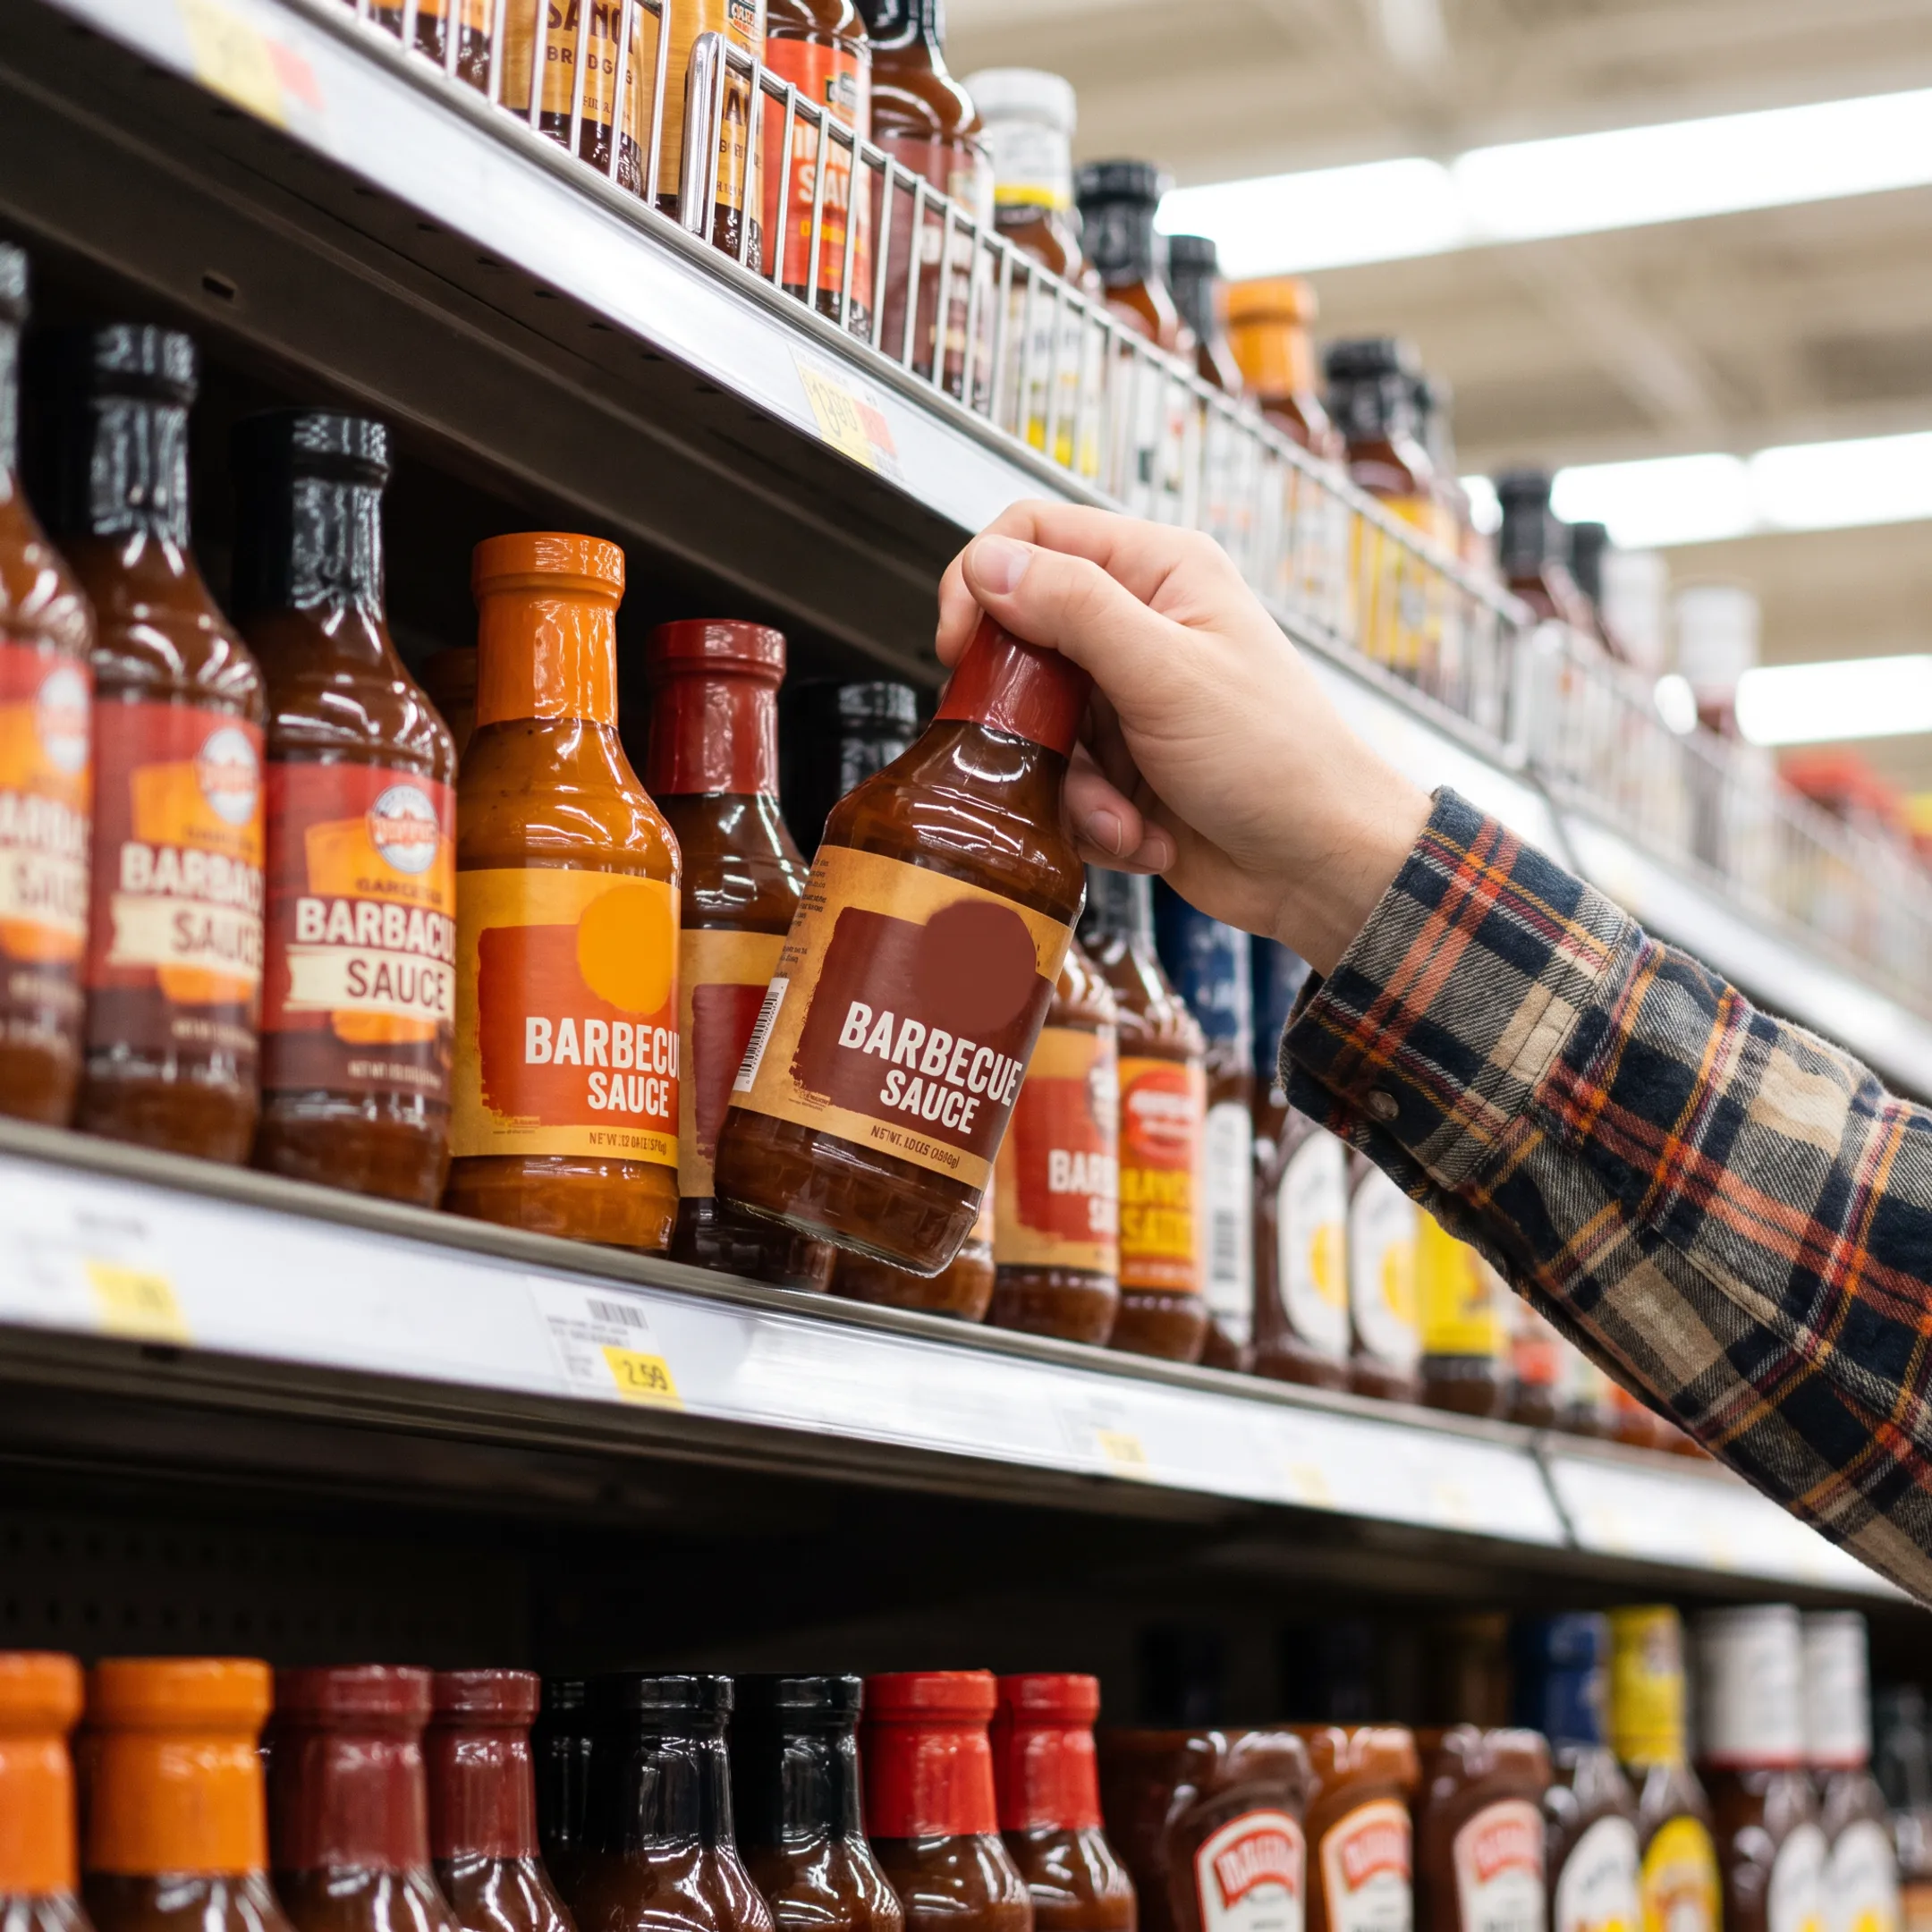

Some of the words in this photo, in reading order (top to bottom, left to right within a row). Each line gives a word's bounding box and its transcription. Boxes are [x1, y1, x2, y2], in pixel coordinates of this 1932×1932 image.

[346, 958, 445, 1012] SAUCE
[525, 1016, 680, 1082] BARBECU
[838, 1000, 1023, 1107] BARBECUE
[587, 1071, 670, 1118] SAUCE
[879, 1069, 981, 1135] SAUCE
